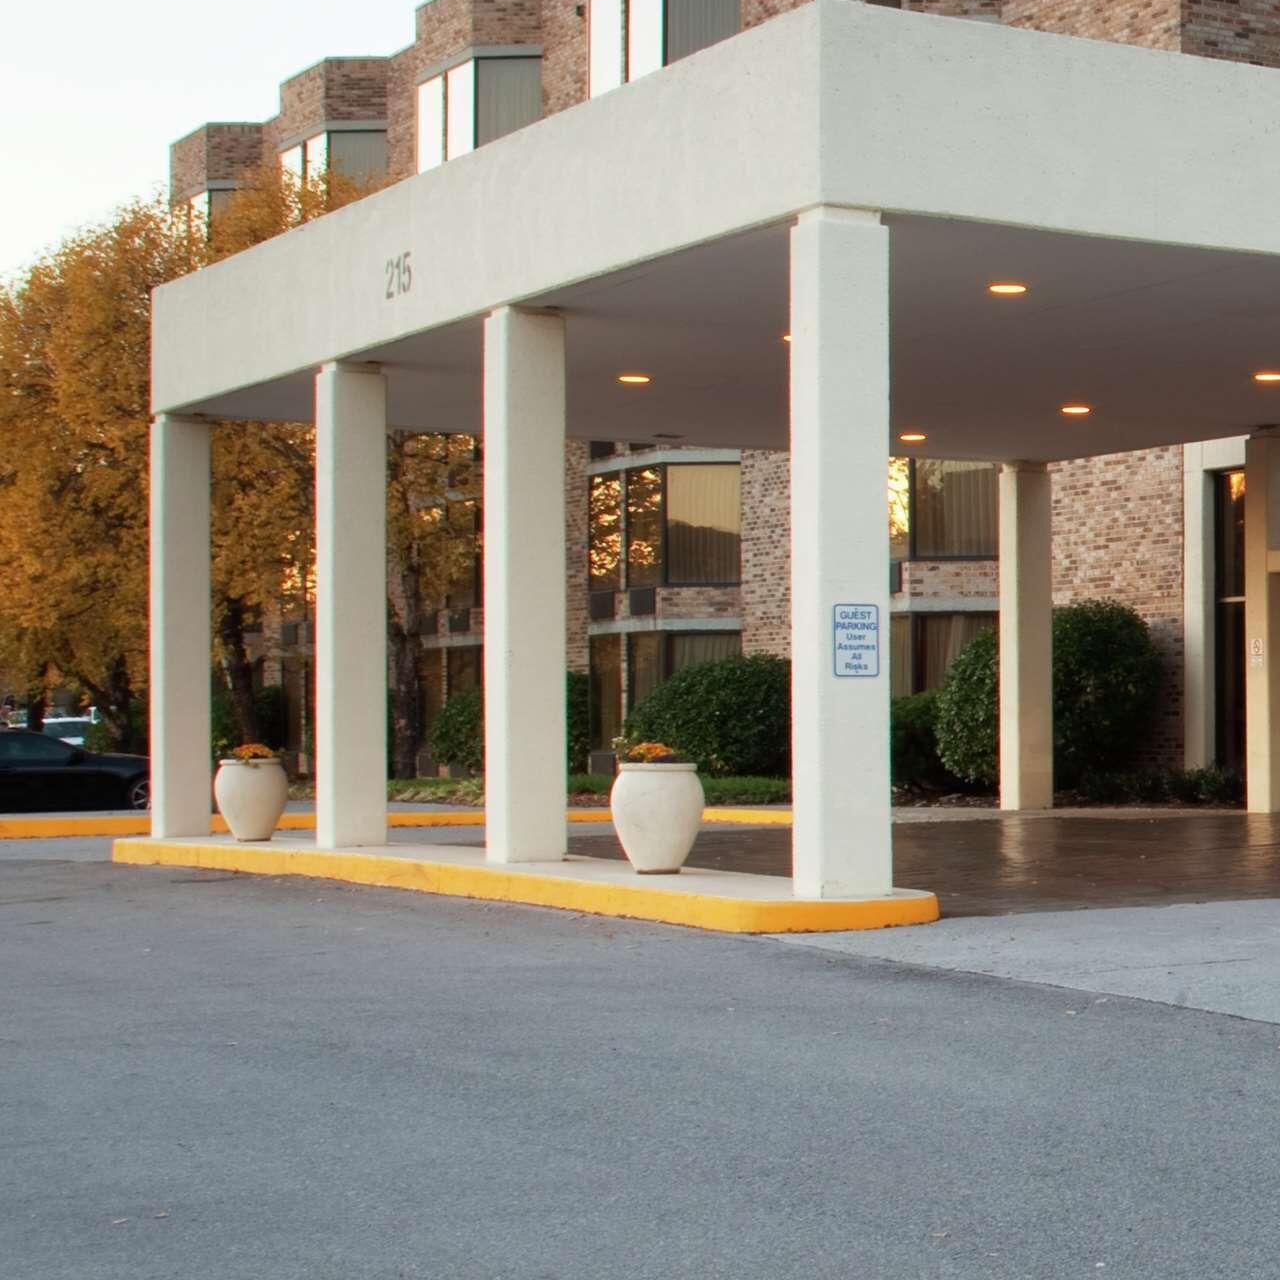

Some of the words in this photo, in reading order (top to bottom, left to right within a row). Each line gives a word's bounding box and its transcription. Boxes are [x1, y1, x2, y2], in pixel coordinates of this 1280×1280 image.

[385, 250, 412, 300] 215
[839, 611, 872, 620] GUEST
[836, 622, 877, 630] PARKING
[837, 642, 876, 650] Assumes
[845, 662, 868, 670] Risks
